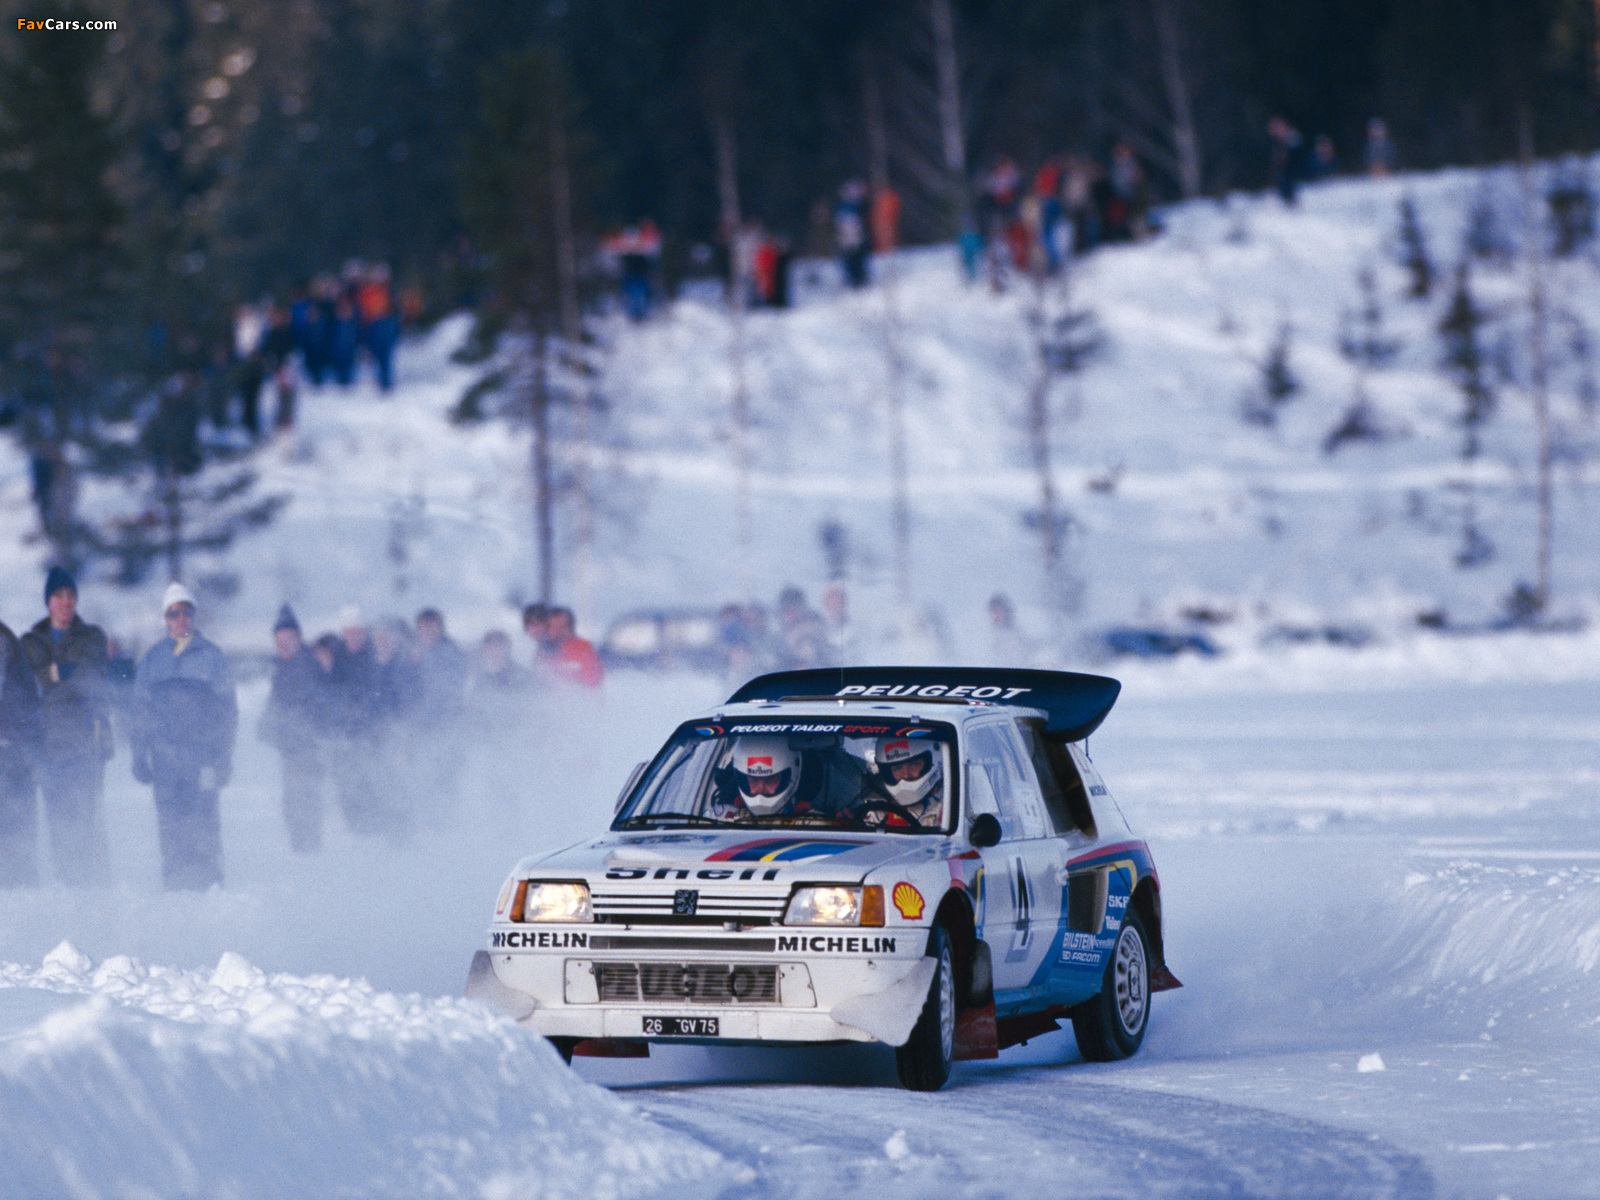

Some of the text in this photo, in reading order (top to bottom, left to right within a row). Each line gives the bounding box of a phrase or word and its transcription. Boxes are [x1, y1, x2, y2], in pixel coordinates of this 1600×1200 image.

[834, 684, 1032, 699] PEUGEOT
[730, 724, 891, 734] PEUGEOT TALBOT SPORT
[747, 766, 773, 775] Marlboro
[1108, 894, 1130, 908] SKF
[778, 936, 896, 953] MICHELIN
[1062, 931, 1096, 950] BILSTEIN
[645, 1019, 663, 1033] 26
[699, 1019, 717, 1034] 75
